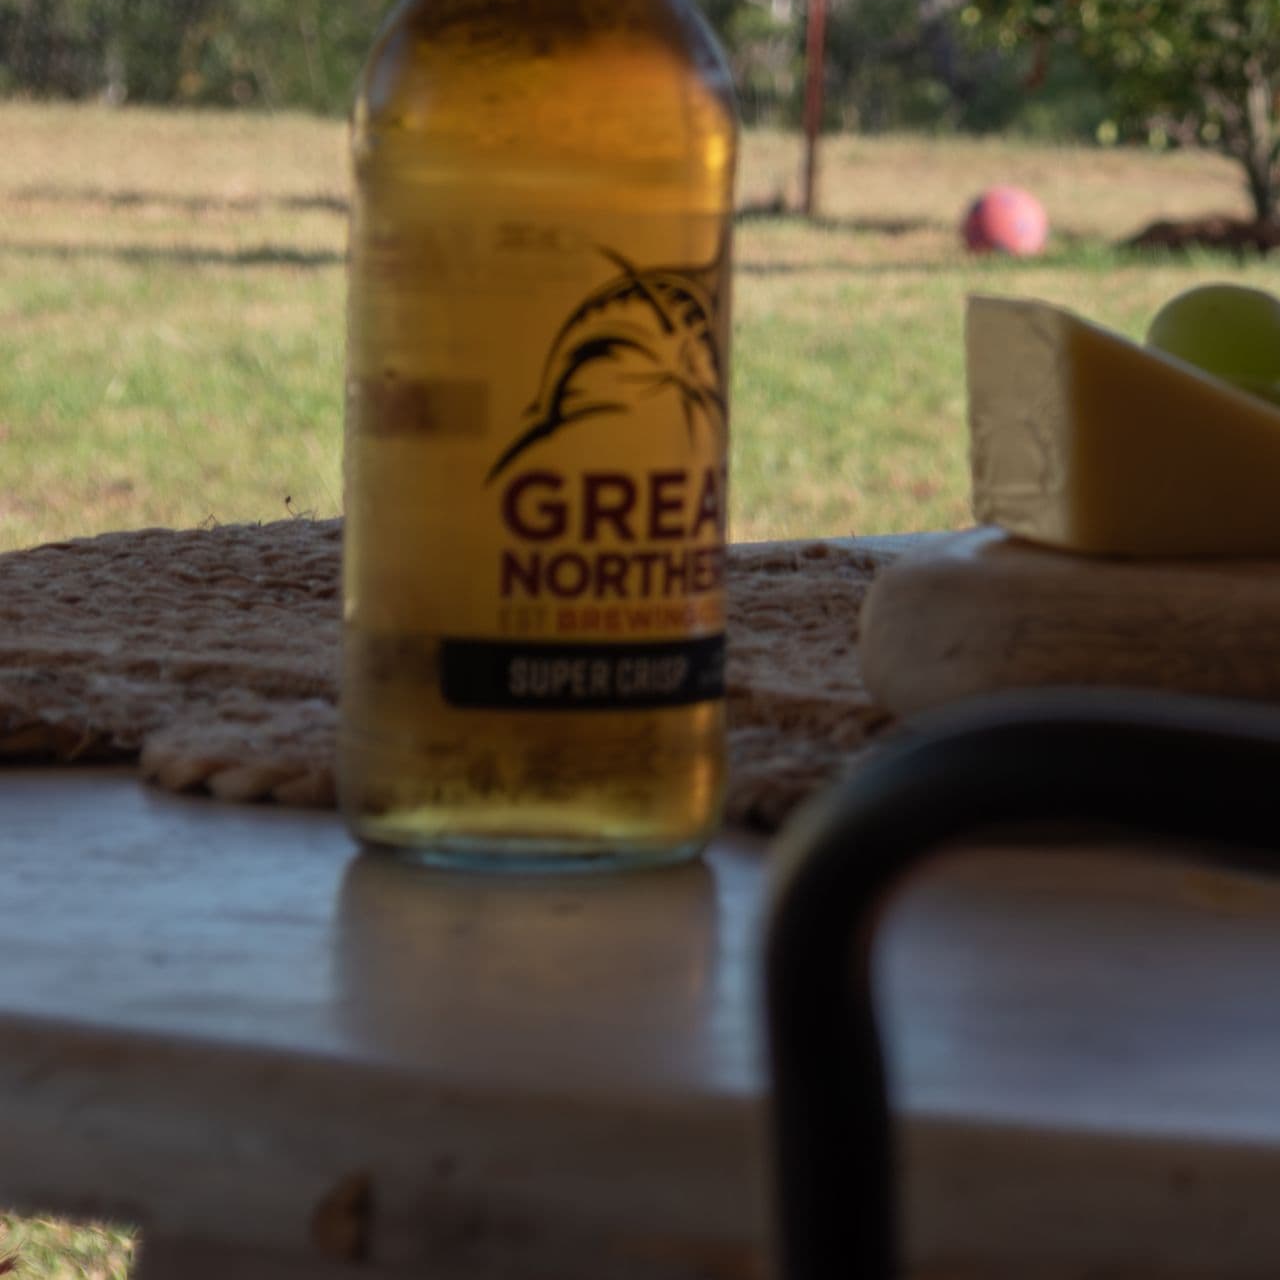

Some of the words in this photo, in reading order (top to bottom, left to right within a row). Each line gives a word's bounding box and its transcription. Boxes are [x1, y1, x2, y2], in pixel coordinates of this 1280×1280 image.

[503, 470, 725, 543] GREA
[501, 548, 724, 600] NORTHE
[508, 655, 610, 697] SUPER
